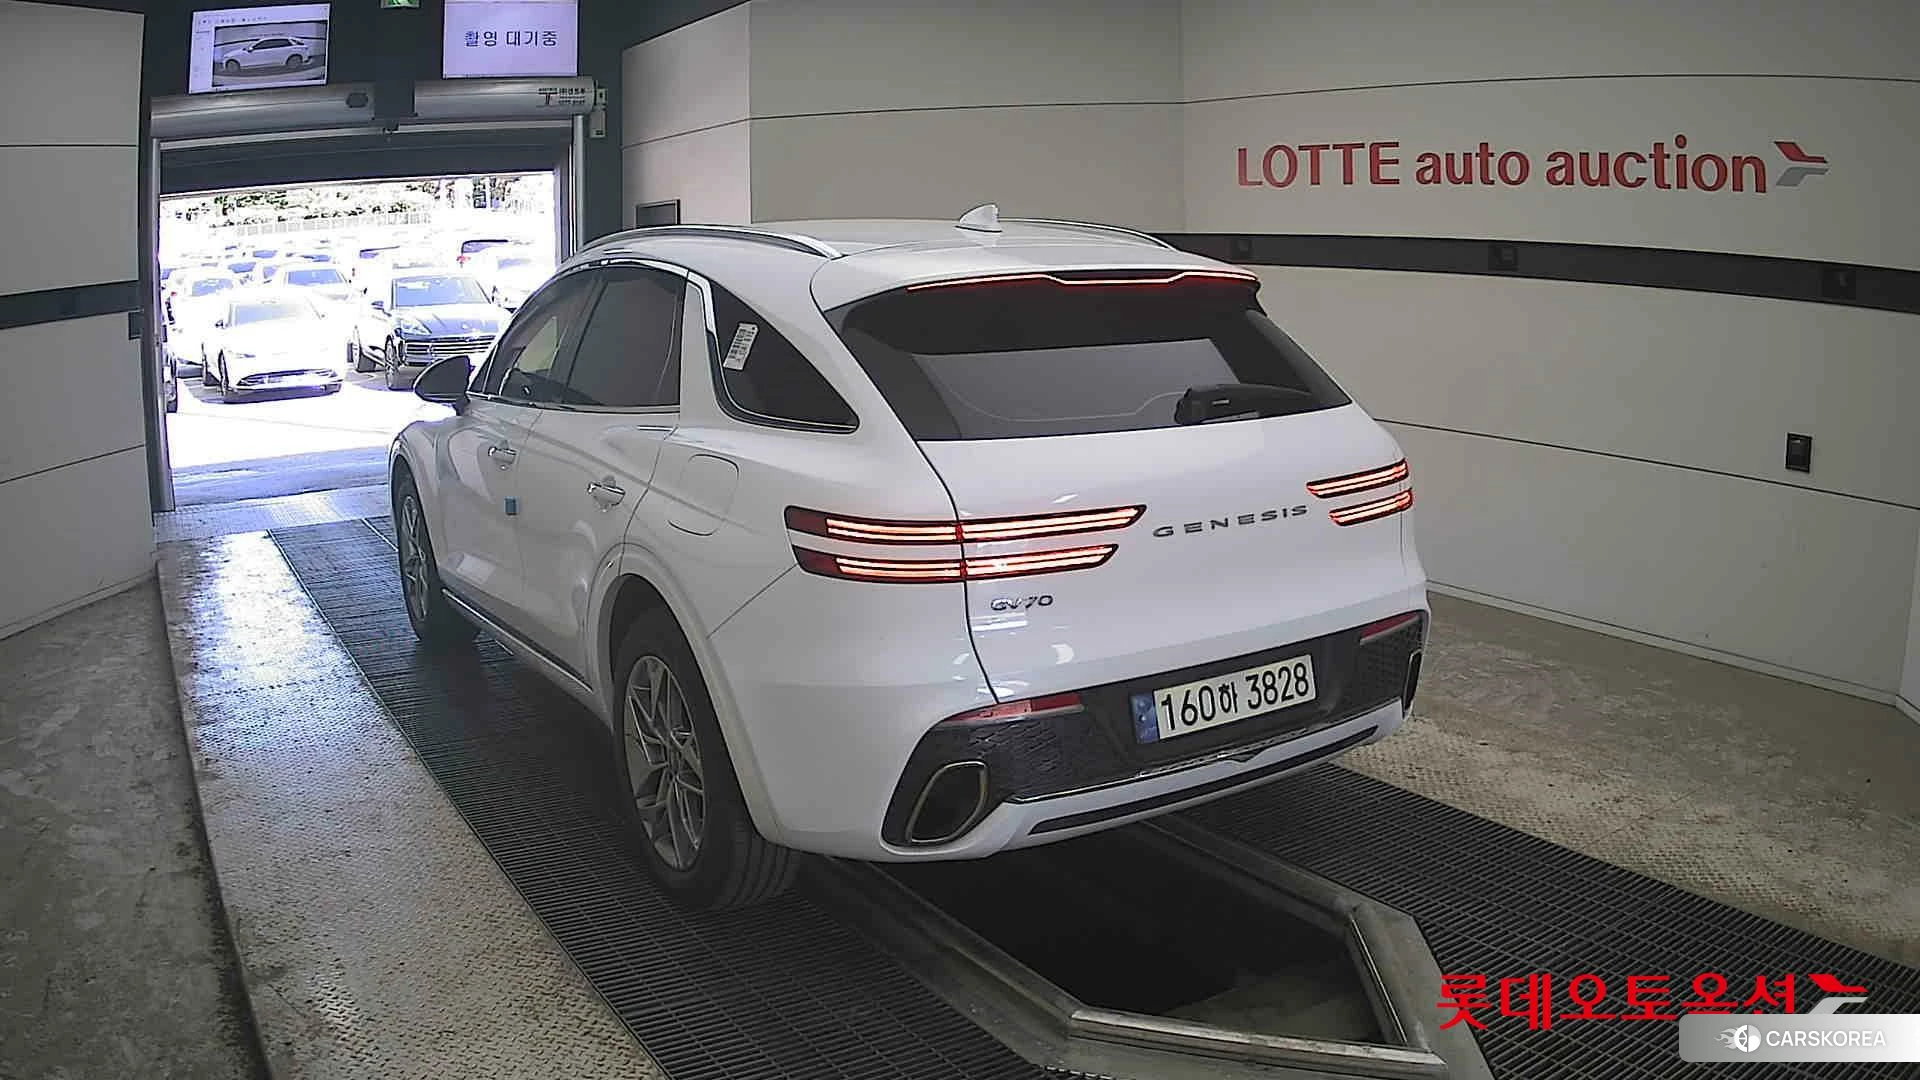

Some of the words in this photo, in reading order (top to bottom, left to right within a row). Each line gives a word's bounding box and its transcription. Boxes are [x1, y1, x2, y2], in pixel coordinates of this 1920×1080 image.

[464, 31, 497, 47] 촬영
[506, 31, 558, 47] 대기중
[1237, 142, 1400, 188] LOTTE
[1415, 142, 1530, 186] auto
[1546, 134, 1767, 194] auction
[1152, 505, 1308, 538] GENESIS
[990, 595, 1054, 611] GV70
[1161, 682, 1239, 731] 160하
[1245, 662, 1309, 709] 3828
